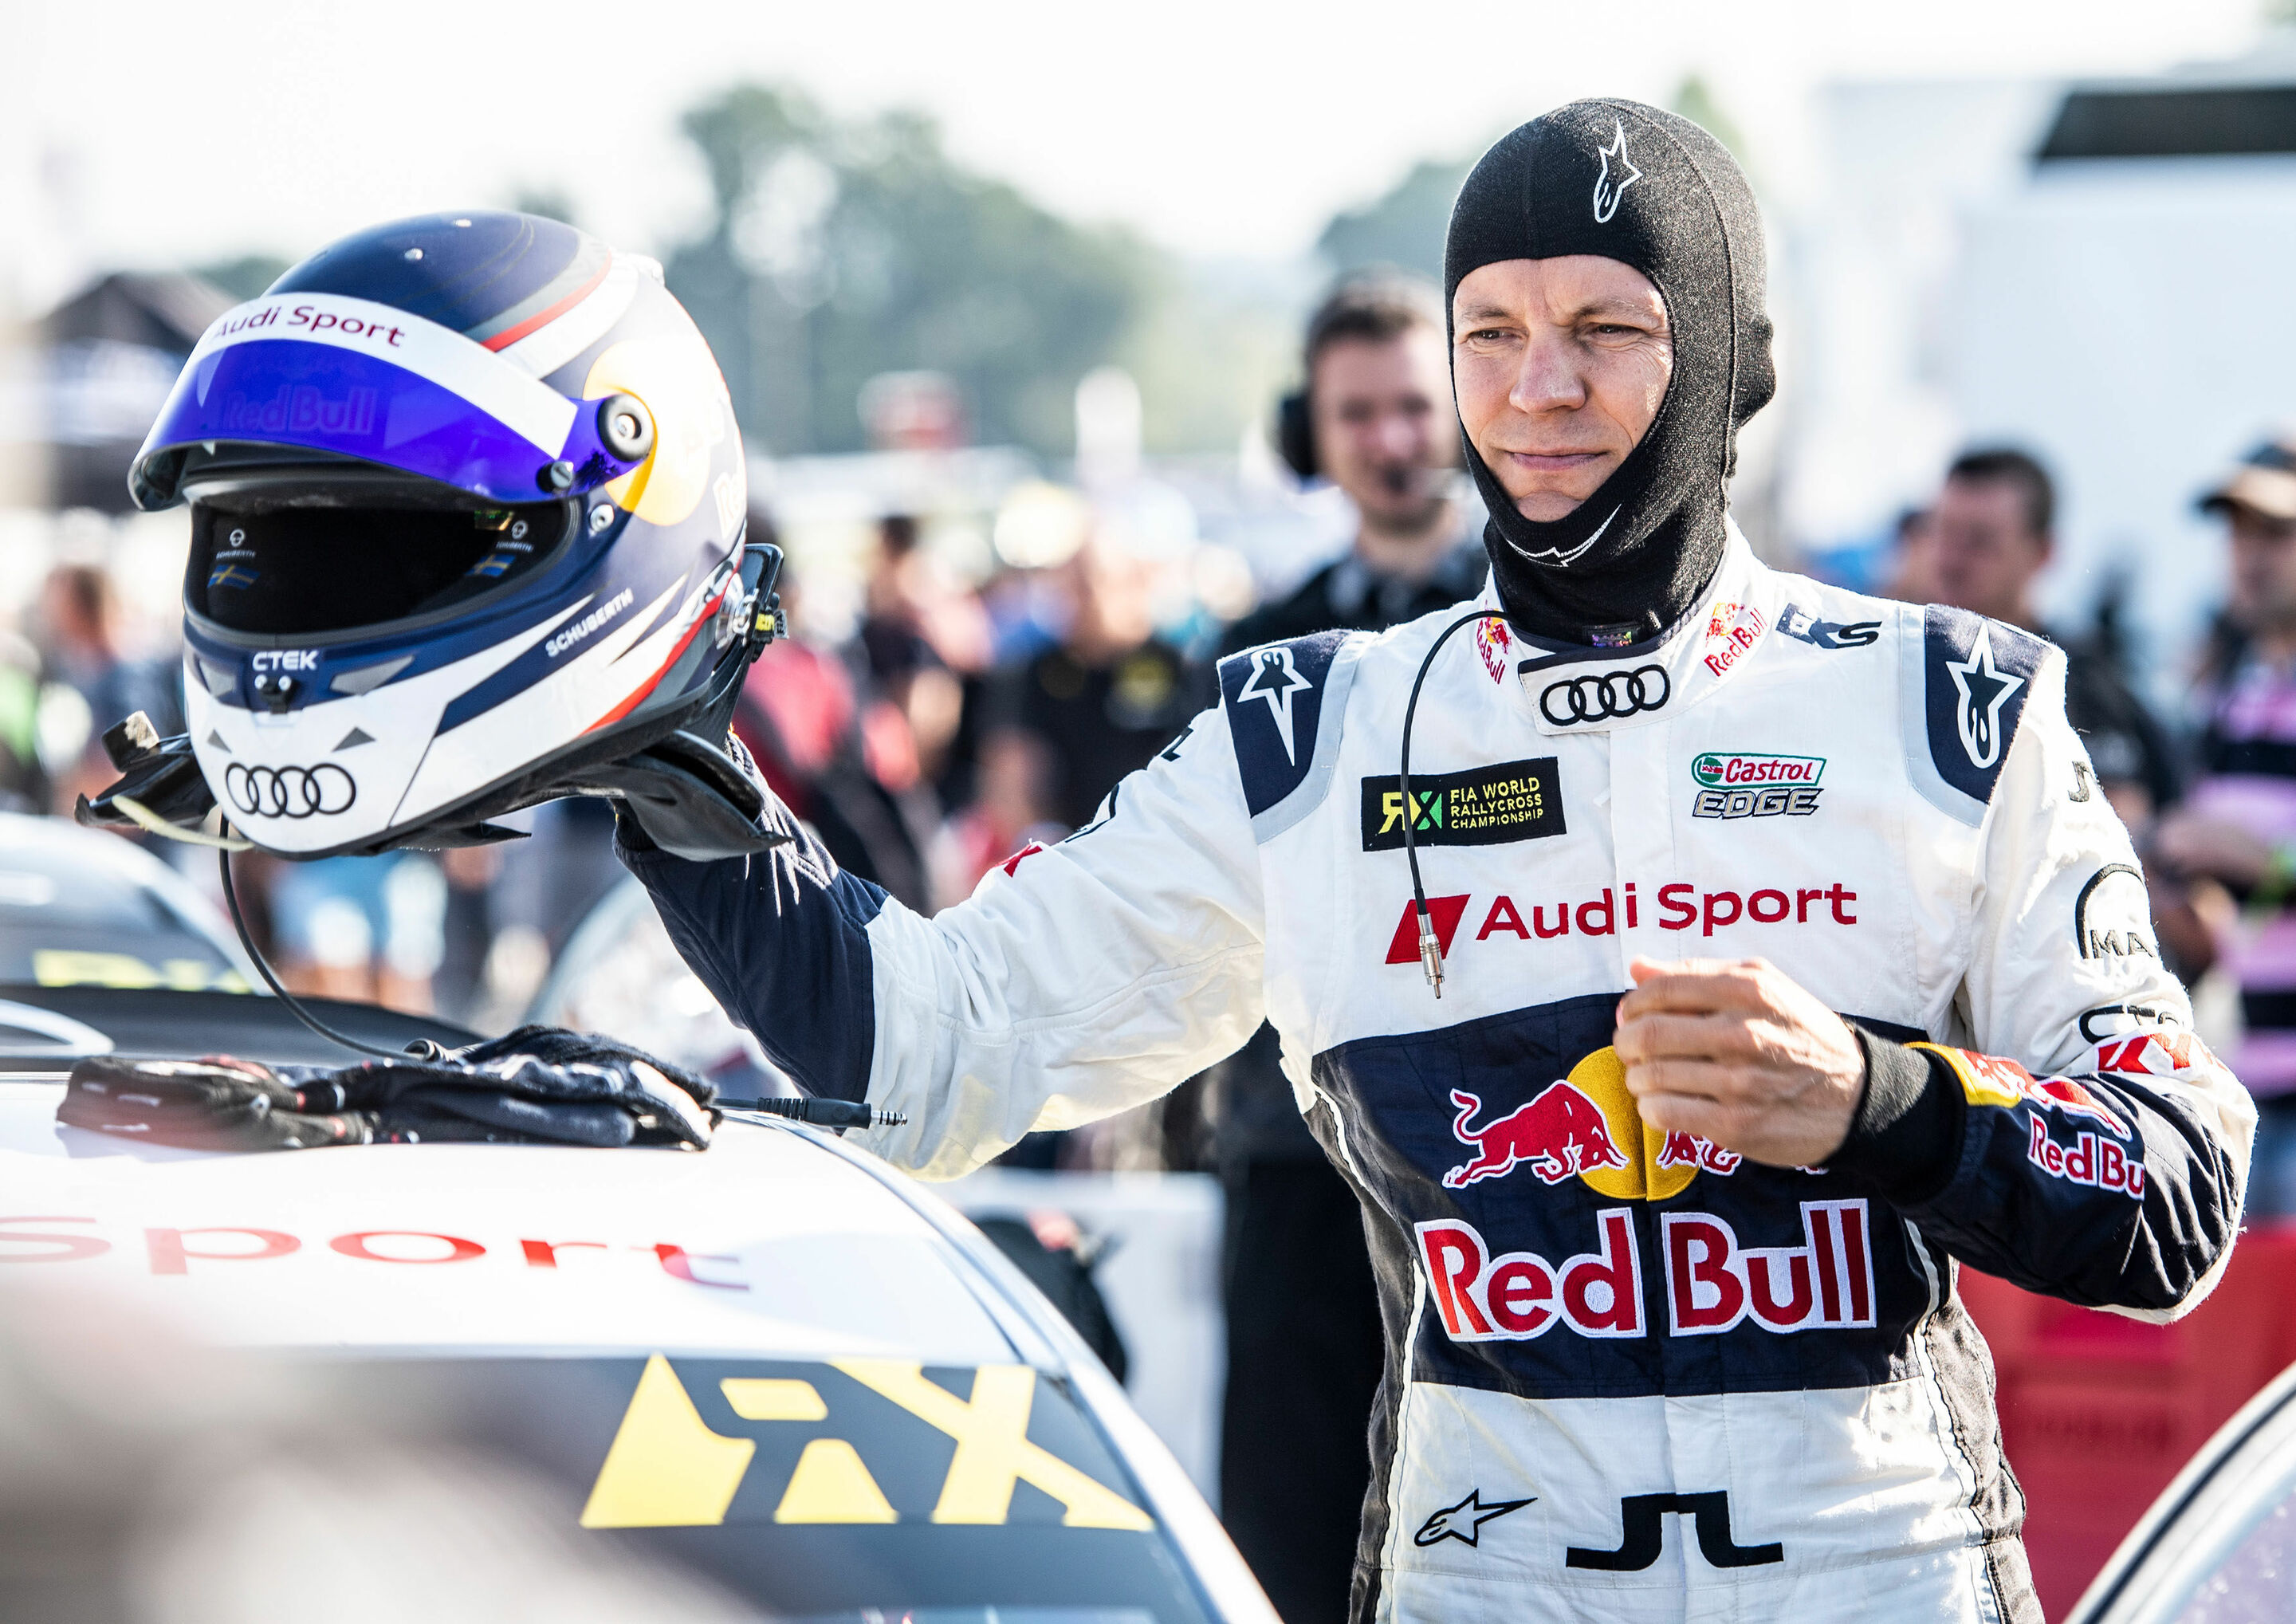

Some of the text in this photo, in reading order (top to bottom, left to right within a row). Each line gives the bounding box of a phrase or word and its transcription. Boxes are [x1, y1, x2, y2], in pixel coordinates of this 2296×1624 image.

[212, 305, 405, 348] Audi Sport
[225, 384, 376, 435] Red Bull
[545, 588, 635, 658] SCHUBERTH
[1704, 607, 1767, 677] Red Bull
[252, 650, 318, 671] CTEK
[1485, 644, 1505, 685] Bull
[1450, 777, 1540, 804] FIA WORLD
[1725, 758, 1813, 783] Castrol
[1450, 793, 1543, 817] RALLYCROSS
[1450, 808, 1544, 829] CHAMPIONSHIP
[1693, 788, 1825, 819] EDGE
[1476, 882, 1857, 940] Audi Sport
[2090, 930, 2158, 959] MA
[2029, 1110, 2145, 1201] Red Bu
[0, 1217, 749, 1292] Sport
[1414, 1198, 1877, 1342] Red Bull
